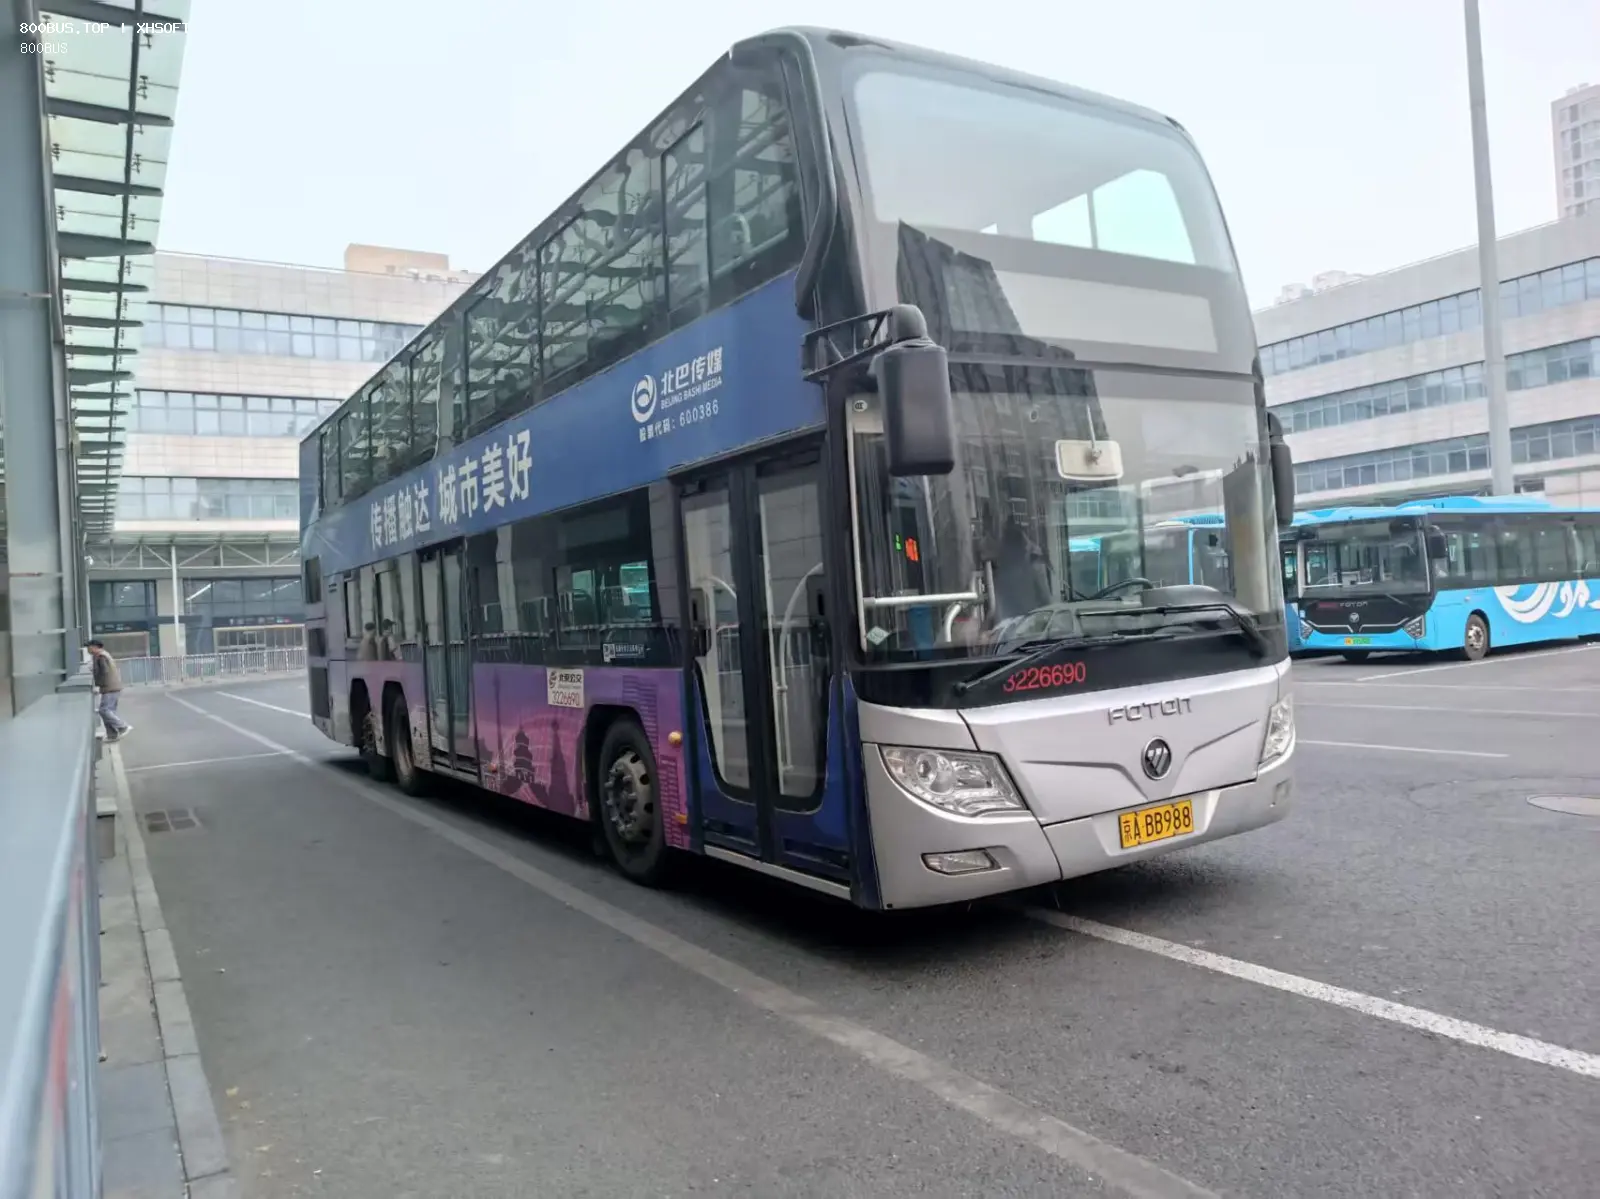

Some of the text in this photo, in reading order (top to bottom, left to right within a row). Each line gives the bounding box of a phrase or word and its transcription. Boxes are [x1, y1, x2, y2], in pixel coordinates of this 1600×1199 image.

[660, 346, 722, 396] 北巴传媒
[661, 375, 723, 410] BEIJING BASHI MEDIA
[370, 429, 532, 551] 传播触达 城市美好
[1003, 661, 1086, 692] 3226690
[1108, 697, 1192, 726] FOTON
